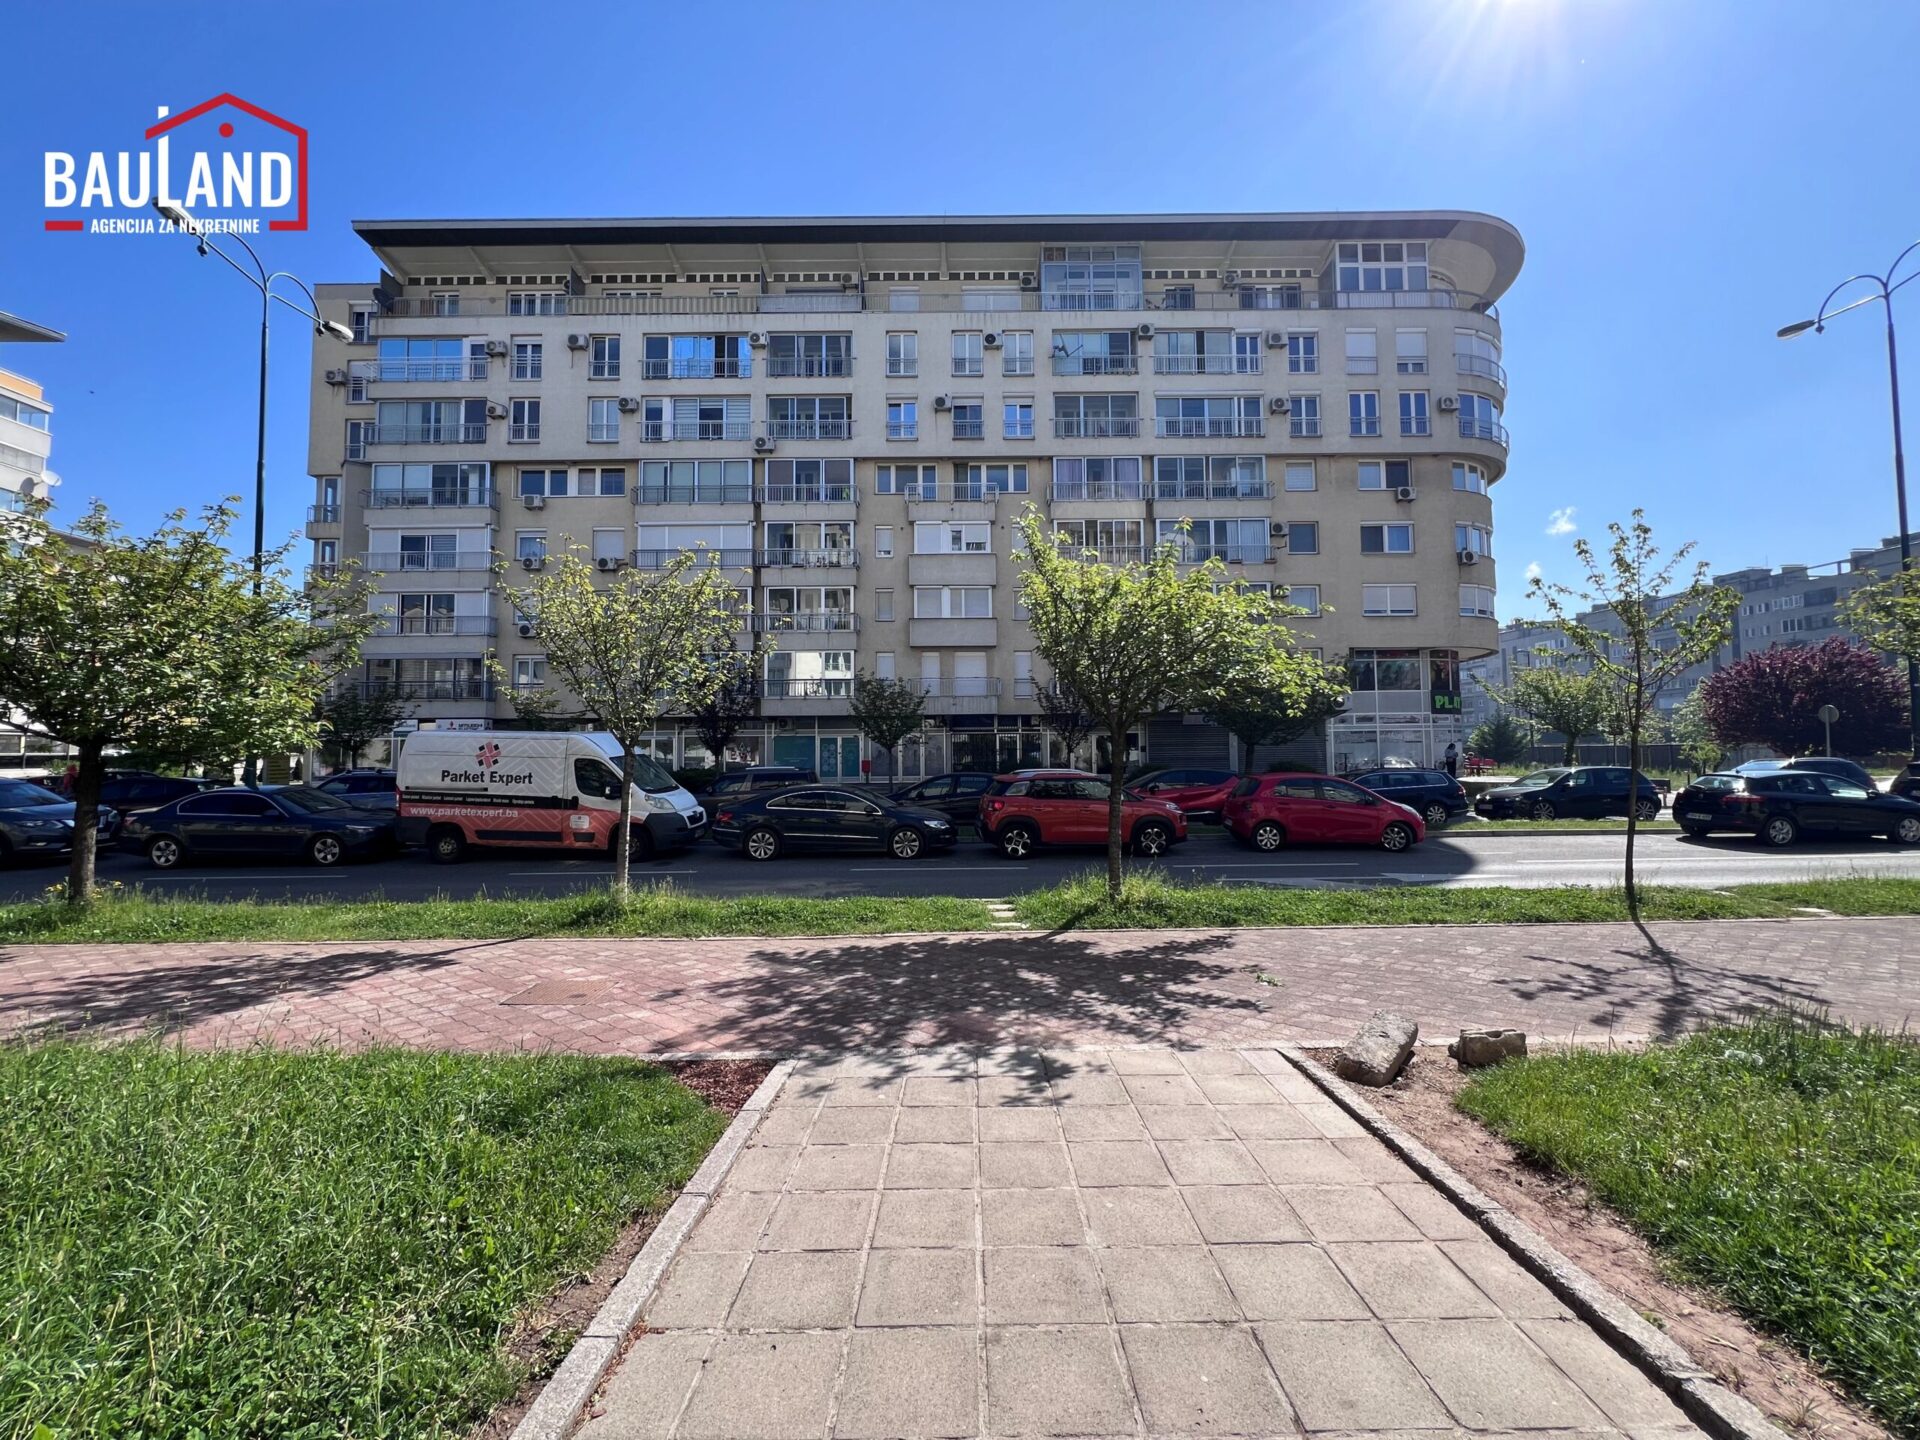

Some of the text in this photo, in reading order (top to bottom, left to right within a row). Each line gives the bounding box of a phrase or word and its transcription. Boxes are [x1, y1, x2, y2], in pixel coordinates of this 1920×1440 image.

[441, 769, 534, 786] Parket Expert
[409, 807, 519, 818] www.parketexpert.ba
